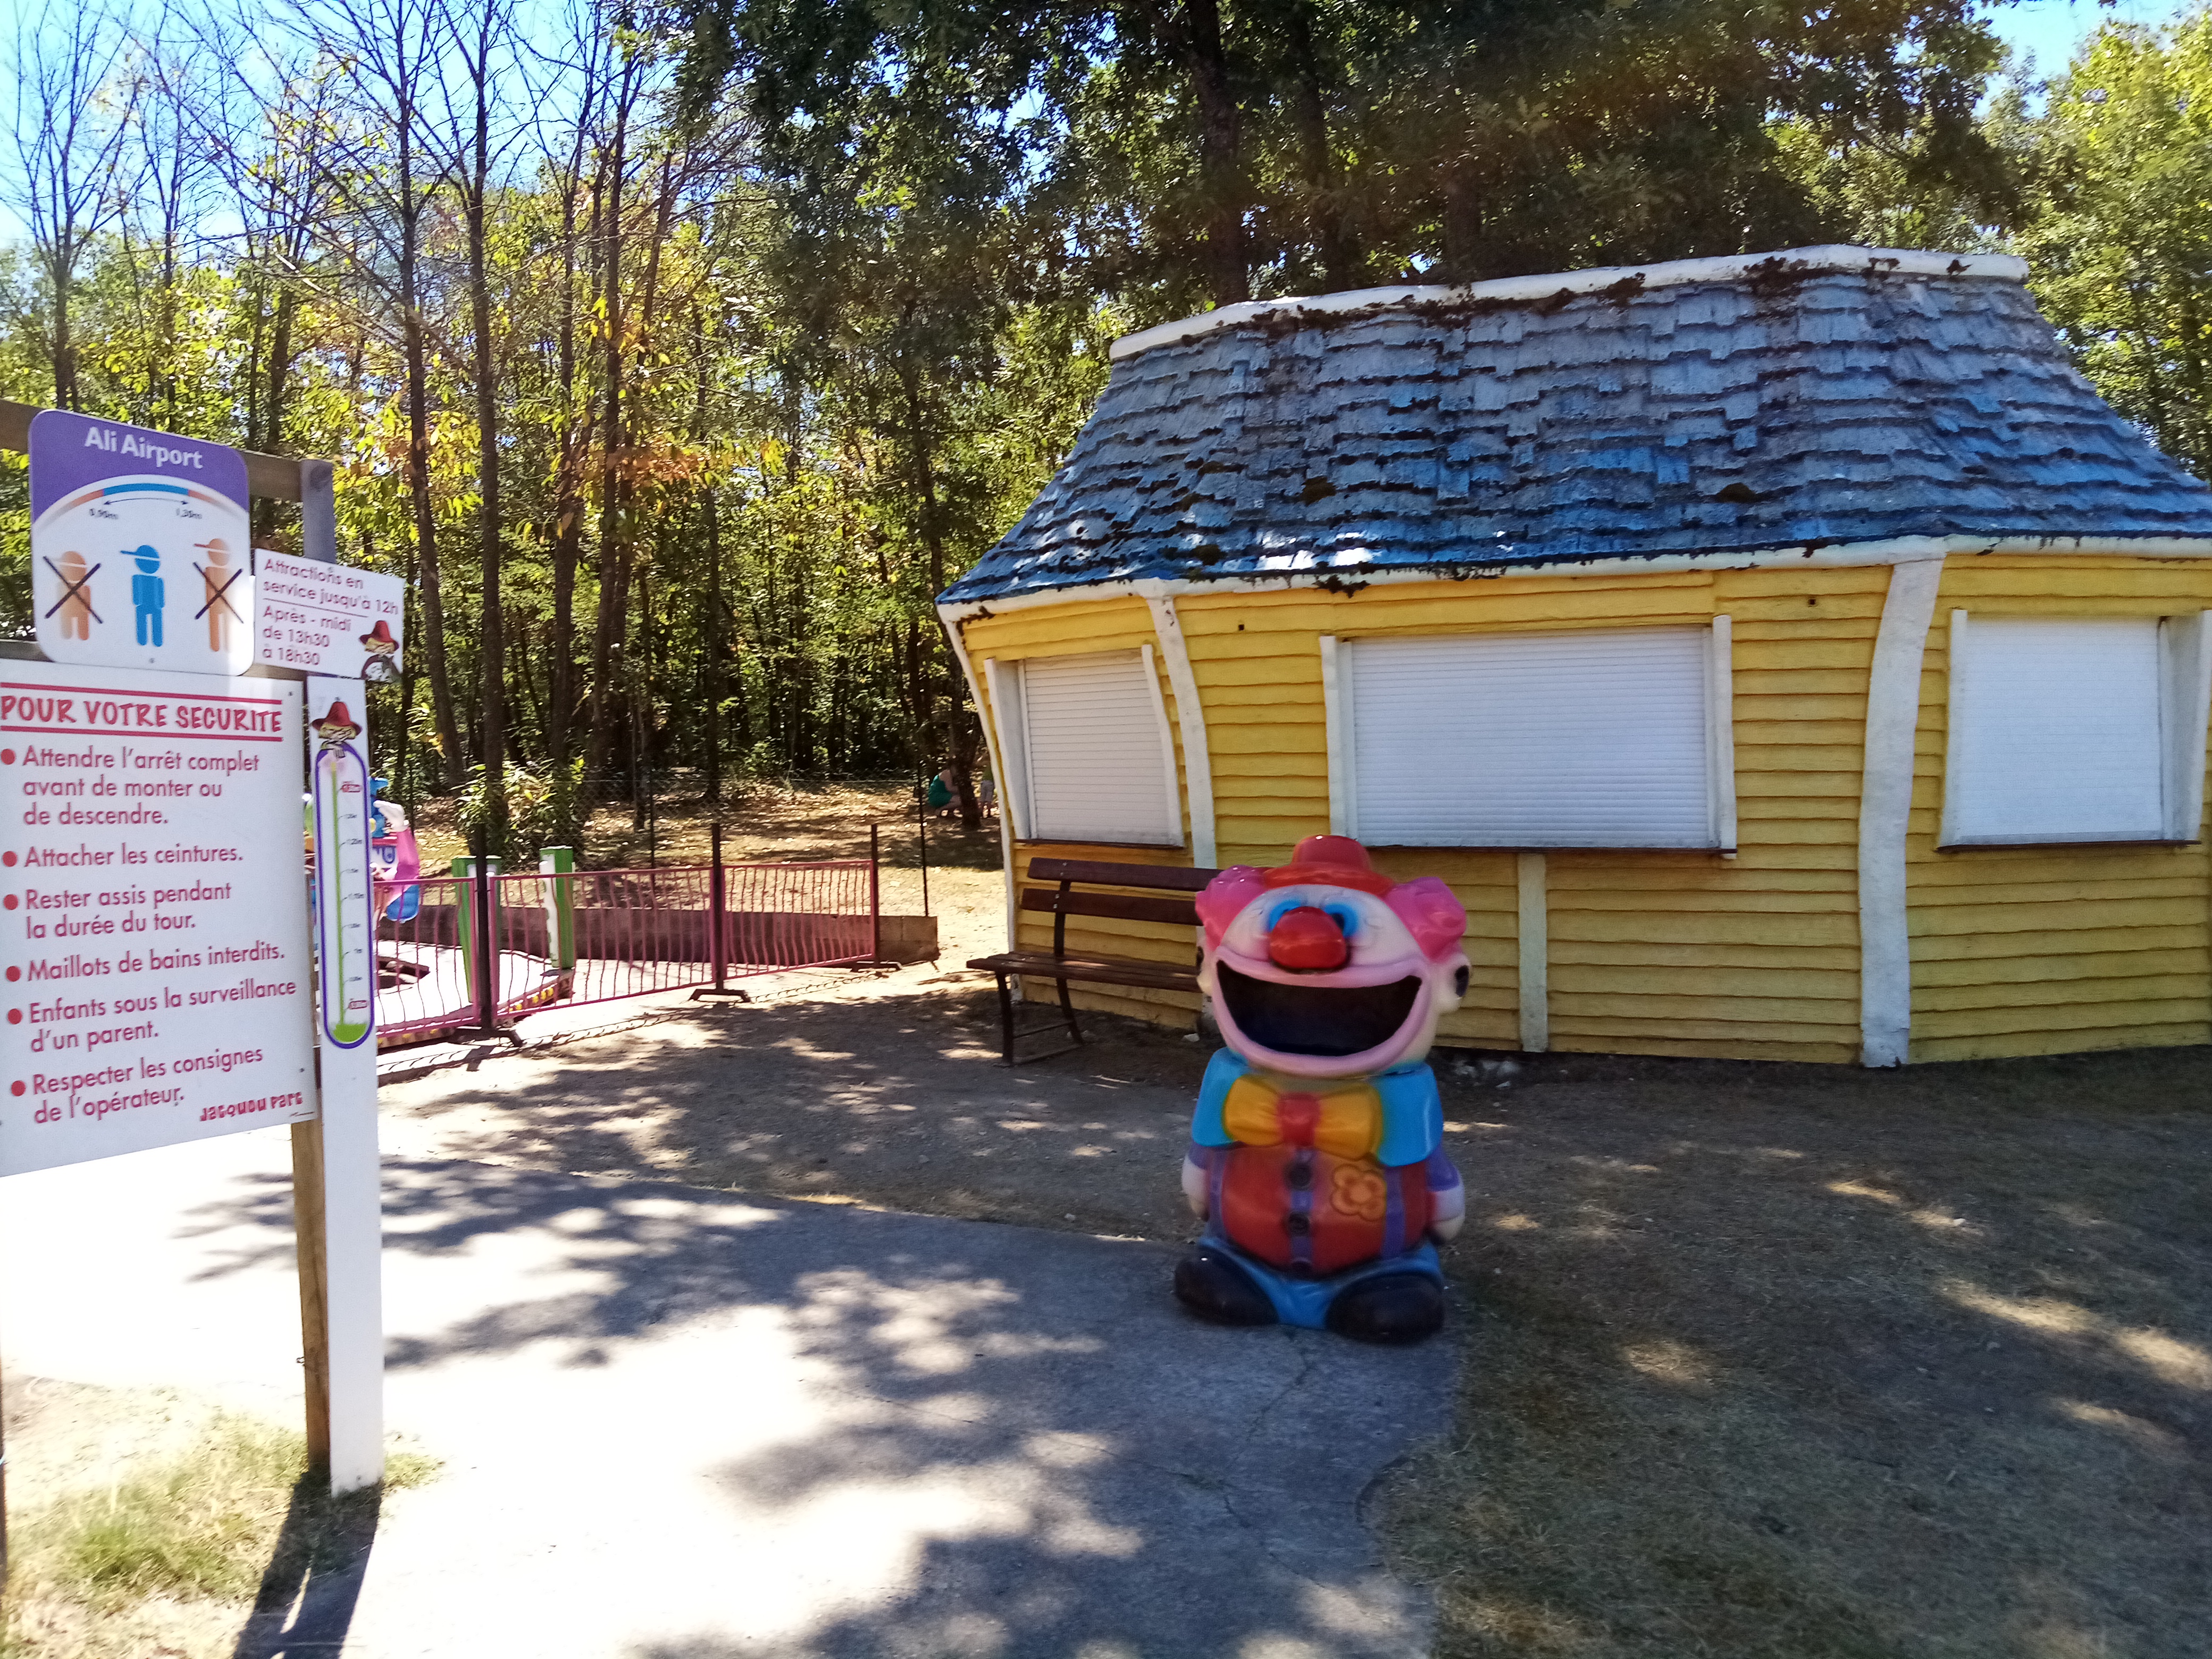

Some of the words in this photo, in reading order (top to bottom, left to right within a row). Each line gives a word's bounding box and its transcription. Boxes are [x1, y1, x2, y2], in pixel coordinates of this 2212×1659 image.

[85, 426, 118, 453] Ali
[121, 434, 203, 467] Airport
[265, 559, 342, 585] Attractions
[346, 578, 363, 589] en
[263, 581, 316, 599] service
[376, 599, 398, 614] 12h
[263, 605, 305, 623] Après
[320, 617, 351, 631] midi
[263, 626, 282, 639] de
[288, 630, 330, 647] 13h30
[278, 648, 320, 665] 18h30
[1, 696, 76, 723] POUR
[84, 701, 166, 726] VOTRE
[175, 706, 282, 732] SECURITE
[22, 745, 115, 769] Attendre
[122, 745, 181, 769] l'arrêt
[188, 750, 258, 776] complet
[23, 774, 85, 796] avant
[91, 773, 117, 797] de
[124, 777, 194, 797] monter
[199, 783, 222, 797] ou
[24, 801, 51, 825] de
[59, 802, 169, 825] descendre.
[24, 844, 114, 867] Attacher
[121, 842, 146, 865] les
[155, 843, 244, 864] ceintures.
[26, 888, 90, 910] Rester
[99, 884, 146, 904] assis
[154, 879, 232, 909] pendant
[27, 916, 46, 939] la
[55, 912, 115, 935] durée
[122, 910, 146, 932] du
[154, 912, 196, 931] tour.
[27, 957, 110, 982] Maillots
[118, 950, 143, 973] de
[150, 949, 201, 970] bains
[208, 940, 285, 966] interdits.
[30, 997, 106, 1024] Enfants
[114, 995, 157, 1015] sous
[164, 987, 181, 1008] la
[189, 977, 296, 1006] surveillance
[31, 1028, 78, 1052] d'un
[87, 1020, 158, 1050] parent.
[32, 1065, 135, 1095] Respecter
[140, 1057, 165, 1078] les
[173, 1048, 263, 1072] consignes
[34, 1100, 62, 1123] de
[69, 1087, 183, 1121] l'opérateur.
